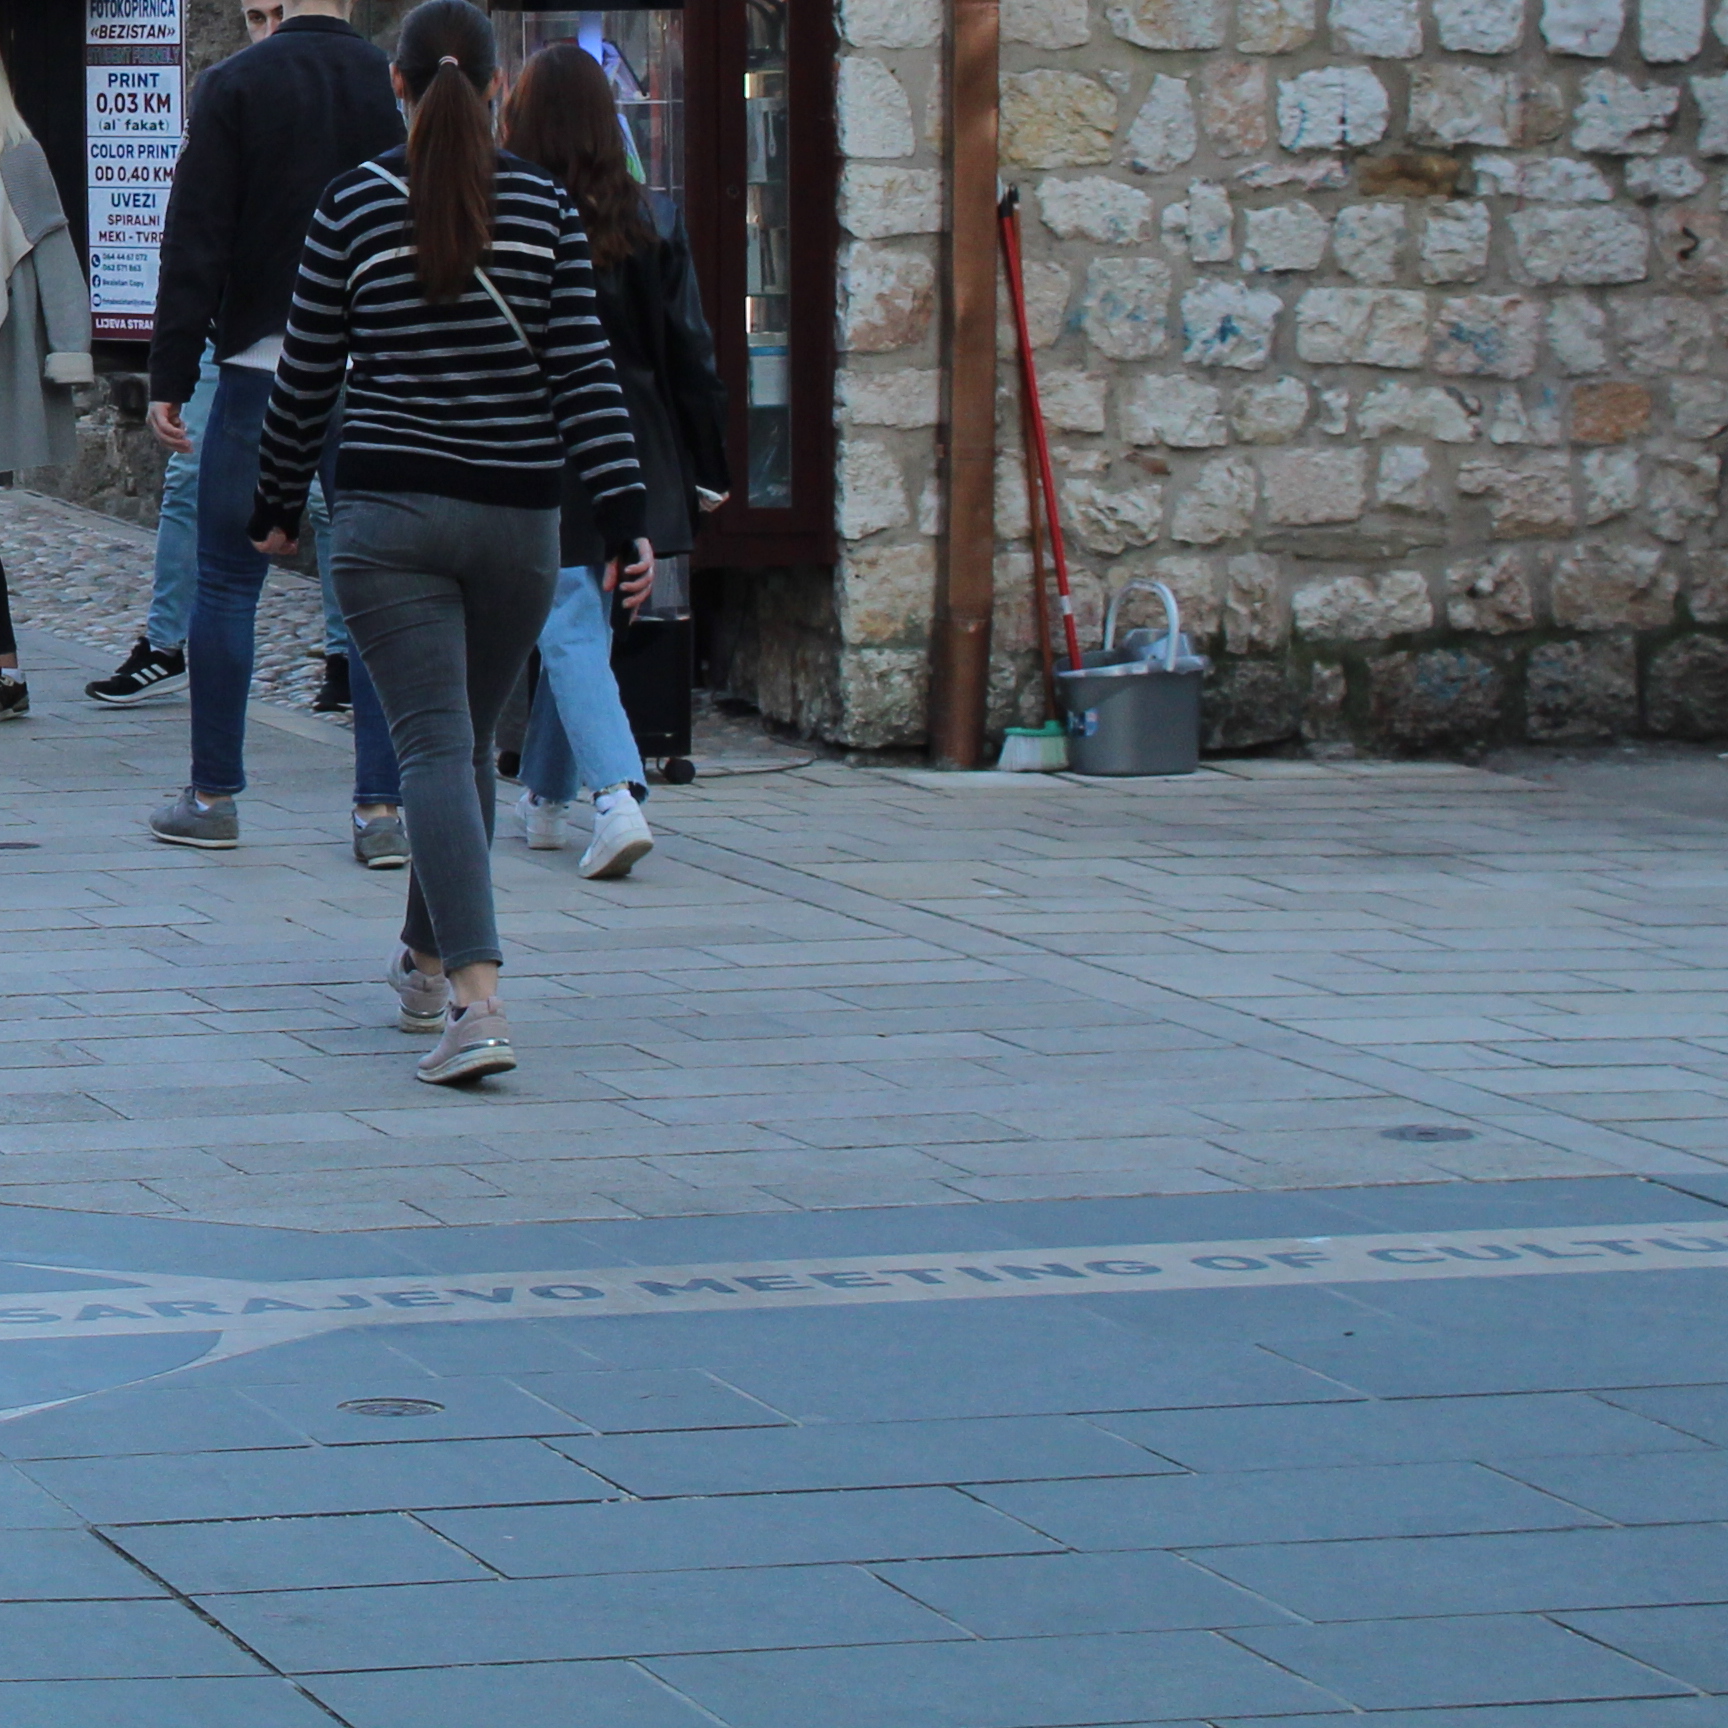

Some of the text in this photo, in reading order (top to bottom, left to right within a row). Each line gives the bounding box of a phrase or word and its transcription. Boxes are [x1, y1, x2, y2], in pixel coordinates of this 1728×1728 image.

[108, 73, 160, 88] PRINT
[96, 93, 171, 114] 0,03 KM
[90, 143, 179, 159] COLOR PRINT
[95, 166, 174, 183] OD 0,40 KM
[111, 193, 156, 208] UVEZI
[107, 215, 160, 226] SPIRALNI
[99, 231, 126, 242] MEKI
[96, 319, 127, 329] LIJEVA
[634, 1259, 1163, 1297] MEETING
[1190, 1250, 1333, 1271] OF
[1367, 1236, 1728, 1264] CULTU
